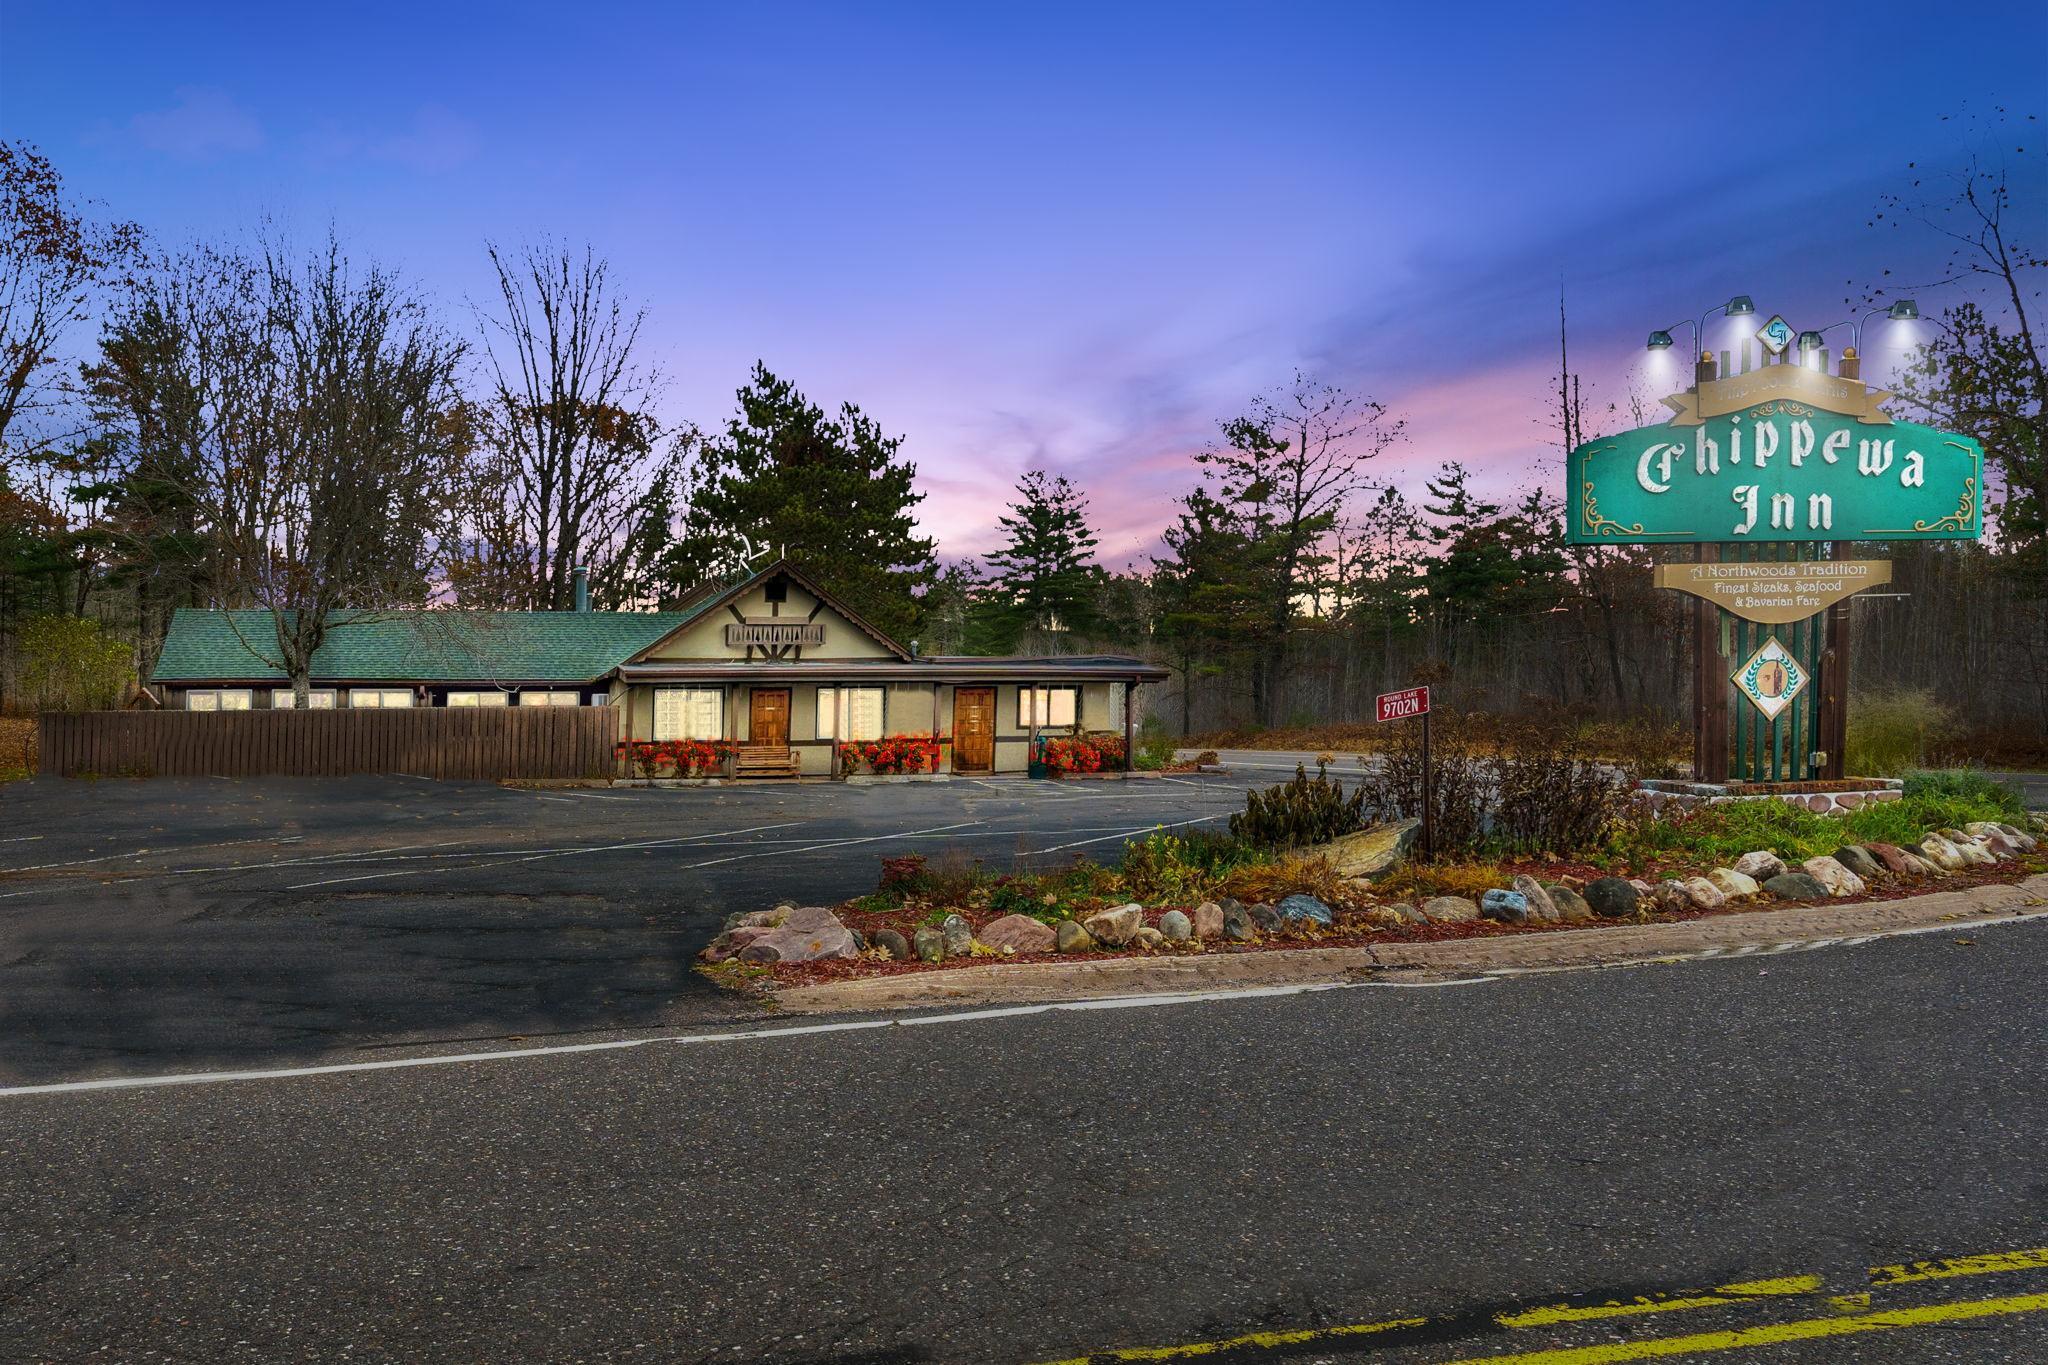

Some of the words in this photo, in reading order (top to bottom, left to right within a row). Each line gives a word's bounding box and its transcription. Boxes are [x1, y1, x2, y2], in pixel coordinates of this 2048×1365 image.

[1636, 415, 1925, 493] Chippewa
[1732, 485, 1832, 535] Inn
[1690, 565, 1703, 581] A
[1707, 564, 1796, 578] Northwoods
[1800, 562, 1867, 576] Tradition
[1714, 582, 1749, 595] Finest
[1751, 581, 1792, 594] Steaks,
[1794, 580, 1842, 594] Seafood
[1735, 597, 1744, 608] &
[1745, 596, 1793, 608] Bavarian
[1796, 594, 1820, 607] Fare
[1383, 694, 1402, 703] ROUND
[1403, 691, 1418, 699] LAKE
[1384, 698, 1419, 718] 9702N
